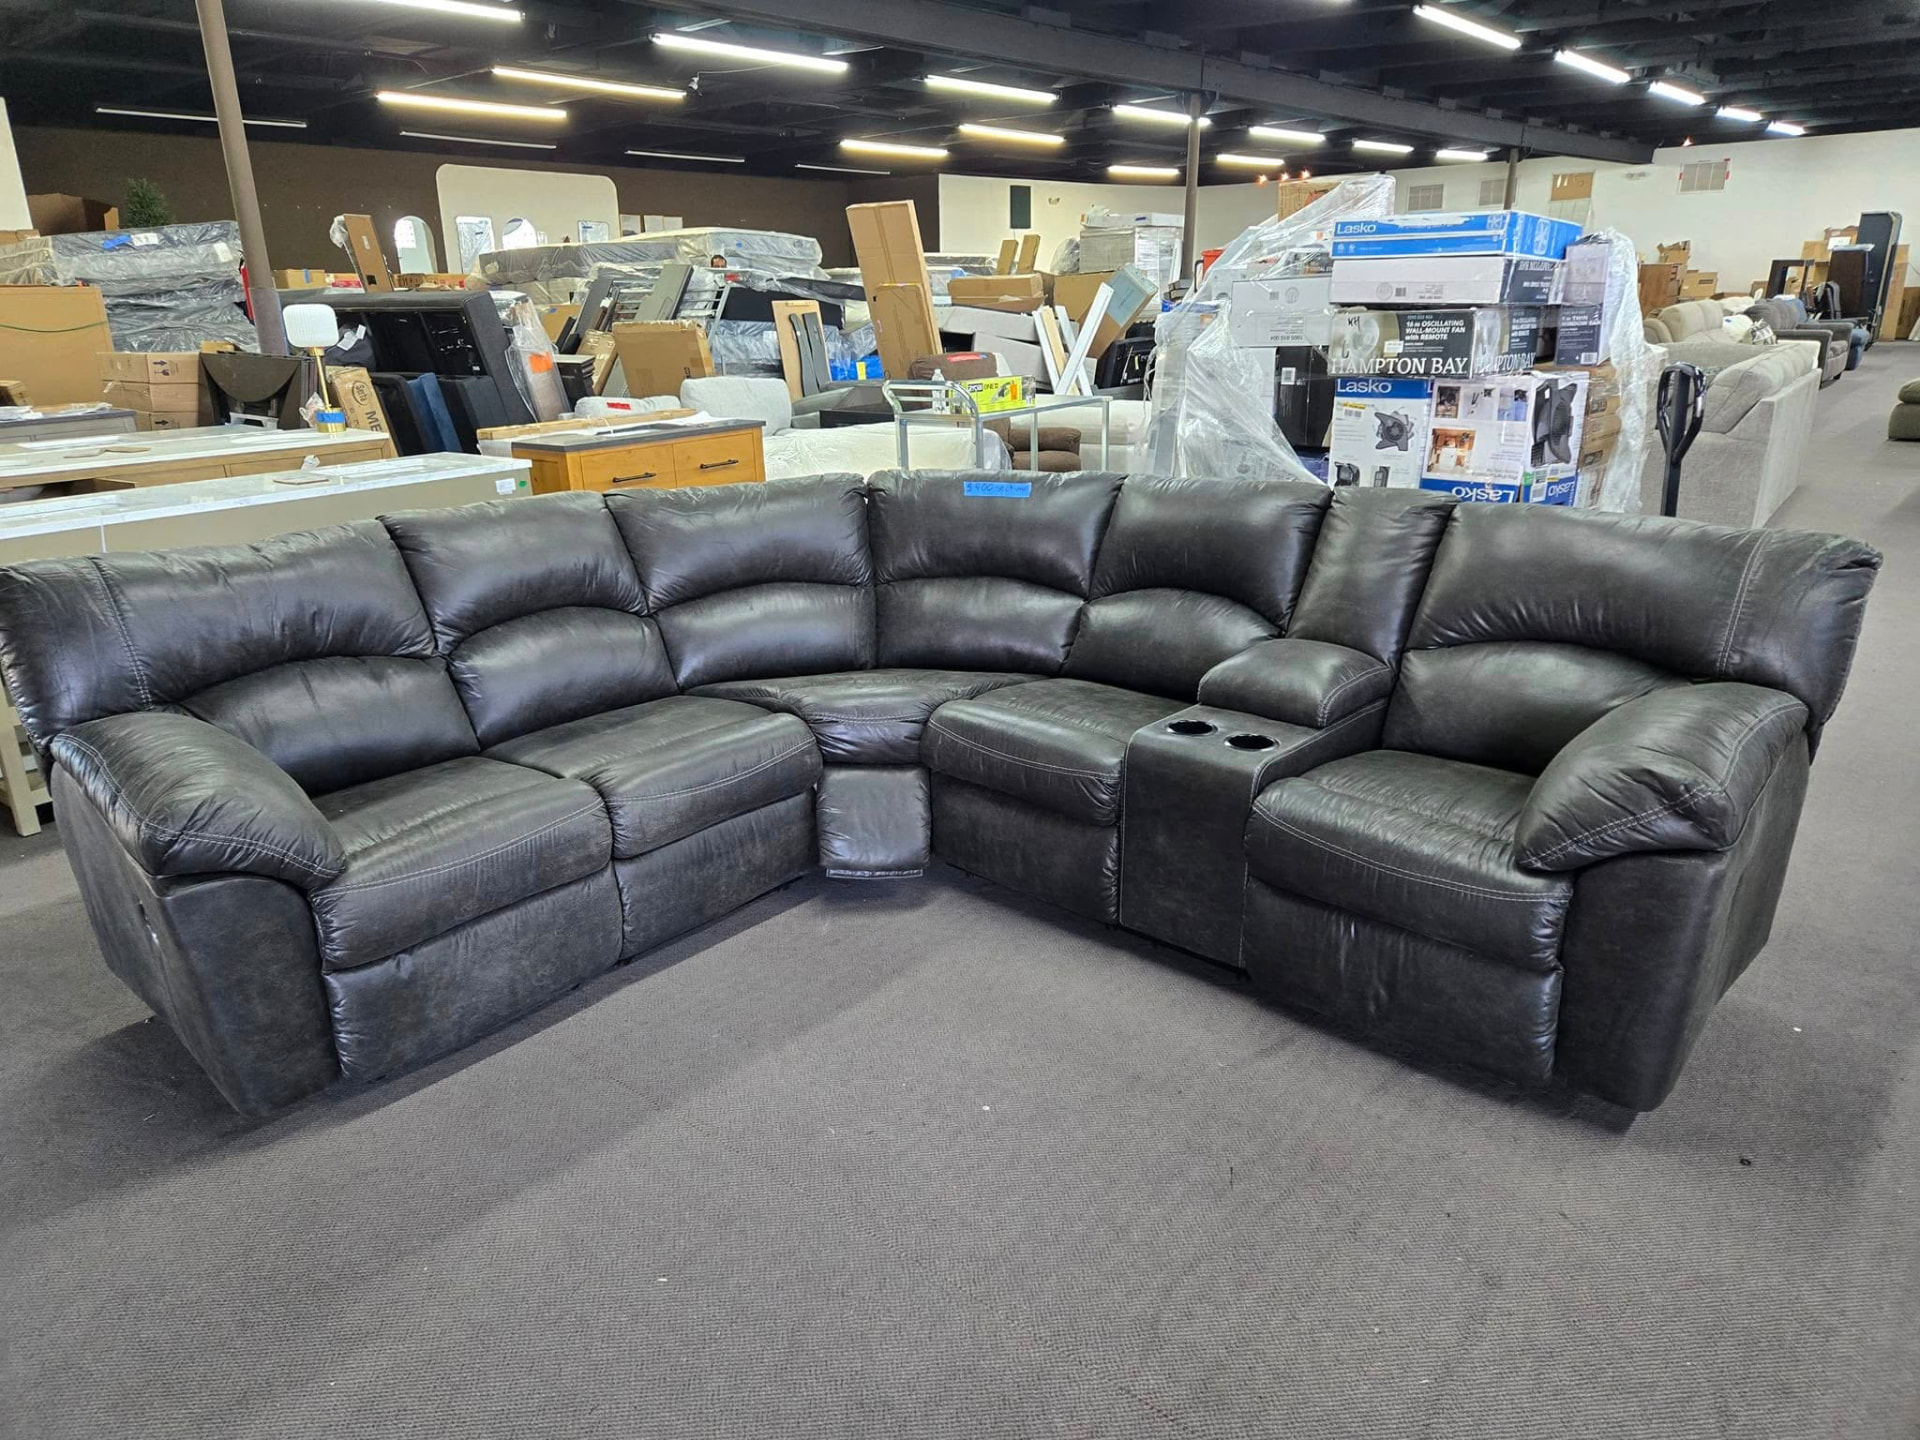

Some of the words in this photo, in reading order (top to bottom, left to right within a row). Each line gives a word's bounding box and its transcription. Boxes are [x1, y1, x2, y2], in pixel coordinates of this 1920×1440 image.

[1337, 223, 1376, 234] Lasko
[1331, 357, 1427, 374] HAMPTON
[1430, 357, 1468, 374] BAY
[1337, 378, 1392, 394] Lasko
[1452, 486, 1515, 503] Lasko
